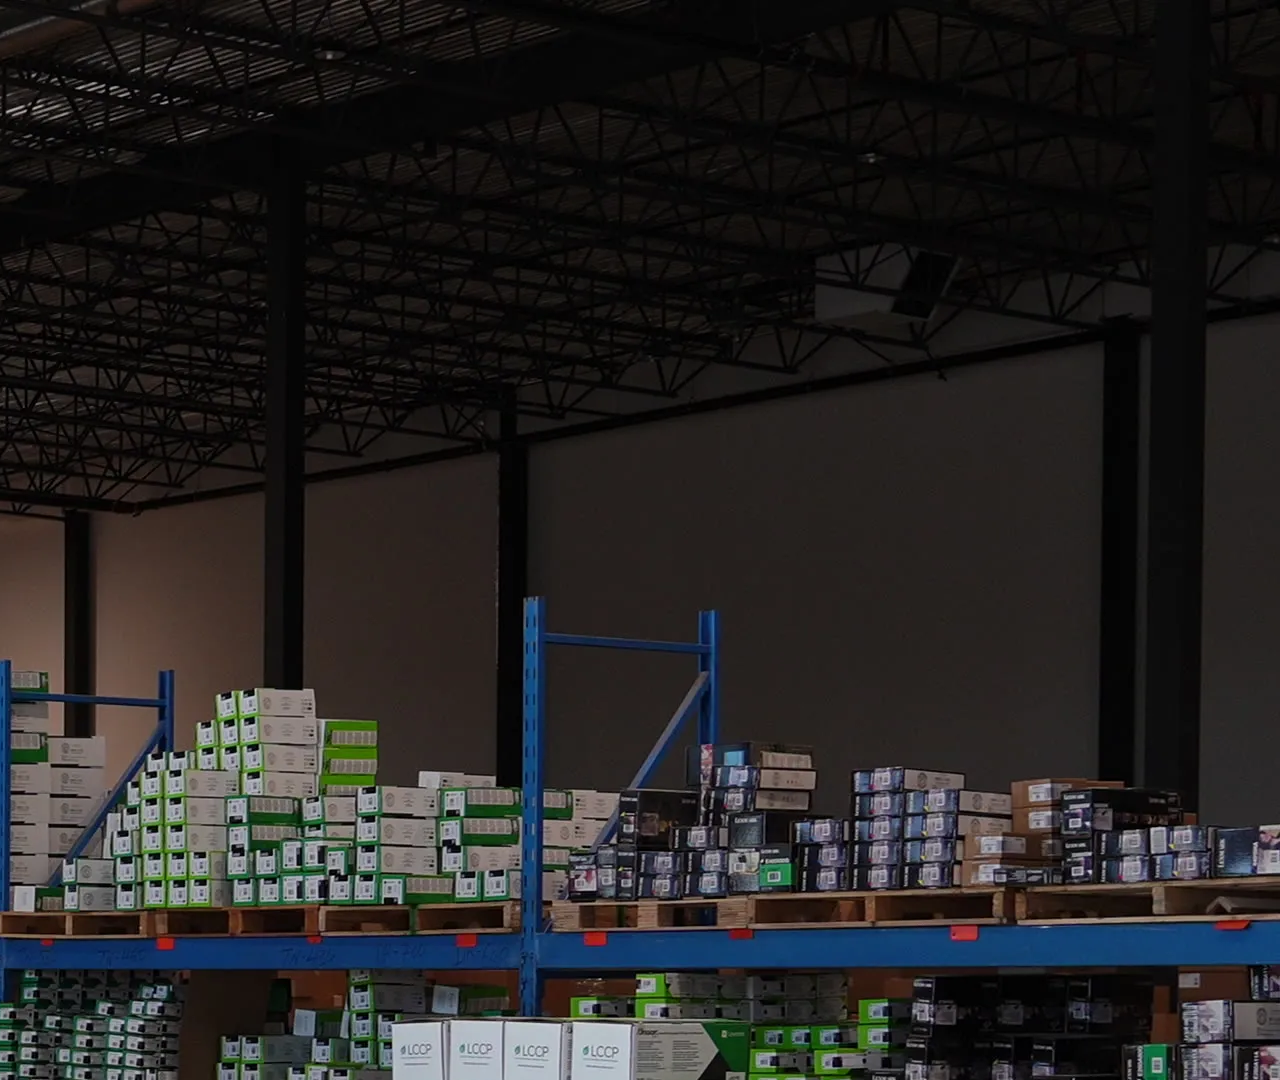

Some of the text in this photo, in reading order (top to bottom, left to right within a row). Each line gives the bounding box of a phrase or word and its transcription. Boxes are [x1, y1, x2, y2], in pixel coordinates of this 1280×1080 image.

[407, 1043, 432, 1055] LCCP
[467, 1043, 493, 1055] LCCP
[522, 1045, 549, 1057] LCCP
[591, 1045, 619, 1058] LCCP
